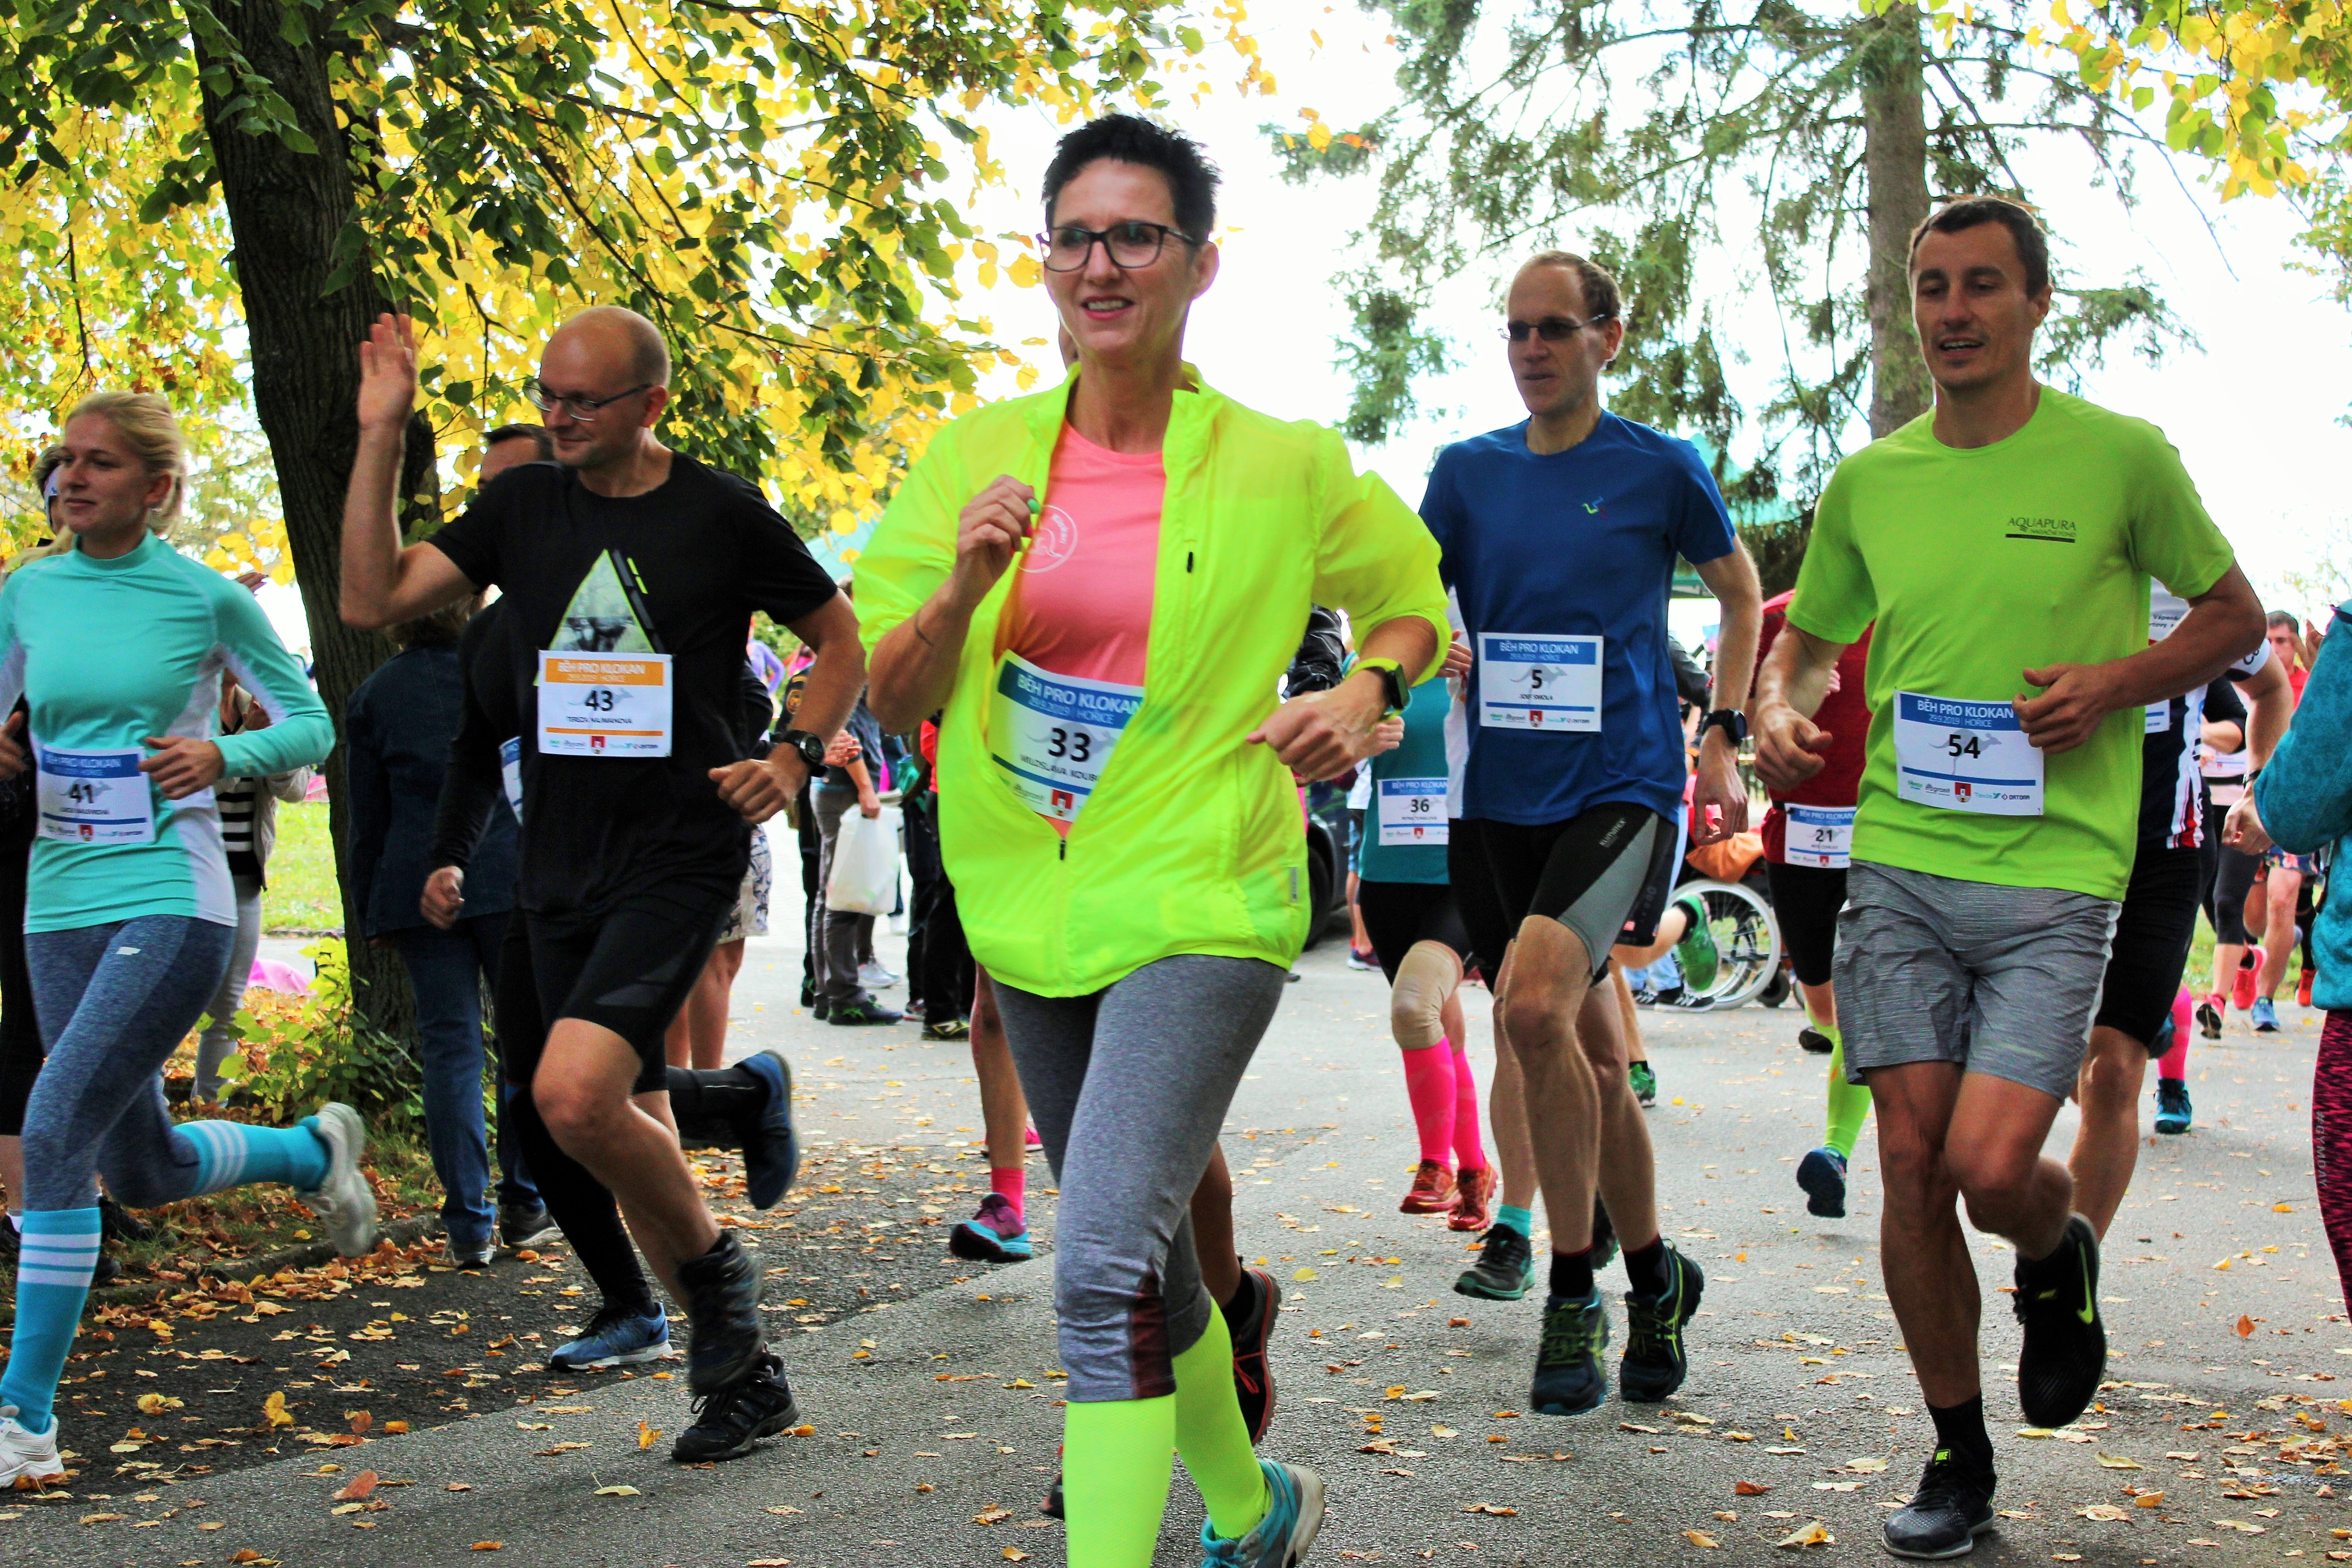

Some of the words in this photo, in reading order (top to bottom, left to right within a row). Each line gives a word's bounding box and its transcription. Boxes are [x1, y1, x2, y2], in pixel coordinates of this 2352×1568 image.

[2008, 517, 2076, 531] AQUAPURA
[1499, 640, 1517, 652] BĚH
[1518, 642, 1538, 652] PRO
[1539, 643, 1579, 654] KLOKAN
[558, 661, 575, 672] BĚH
[578, 662, 599, 673] PRO
[601, 664, 646, 675] KLOKAN
[1532, 669, 1543, 689] 5
[584, 690, 613, 711] 43
[1017, 673, 1042, 696] BĚH
[1045, 687, 1076, 705] PRO
[1079, 693, 1141, 715] KLOKAN
[1076, 709, 1115, 725] HOŘICE
[1917, 699, 1938, 713] BĚH
[1940, 703, 1963, 716] PRO
[1965, 706, 2014, 719] KLOKAN
[1965, 717, 1992, 727] HOŘICE
[1048, 727, 1091, 763] 33
[1948, 734, 1980, 759] 54
[59, 757, 78, 767] PRO
[81, 758, 122, 767] KLOKAN
[69, 784, 95, 804] 41
[1411, 799, 1430, 813] 36
[1815, 829, 1833, 843] 21
